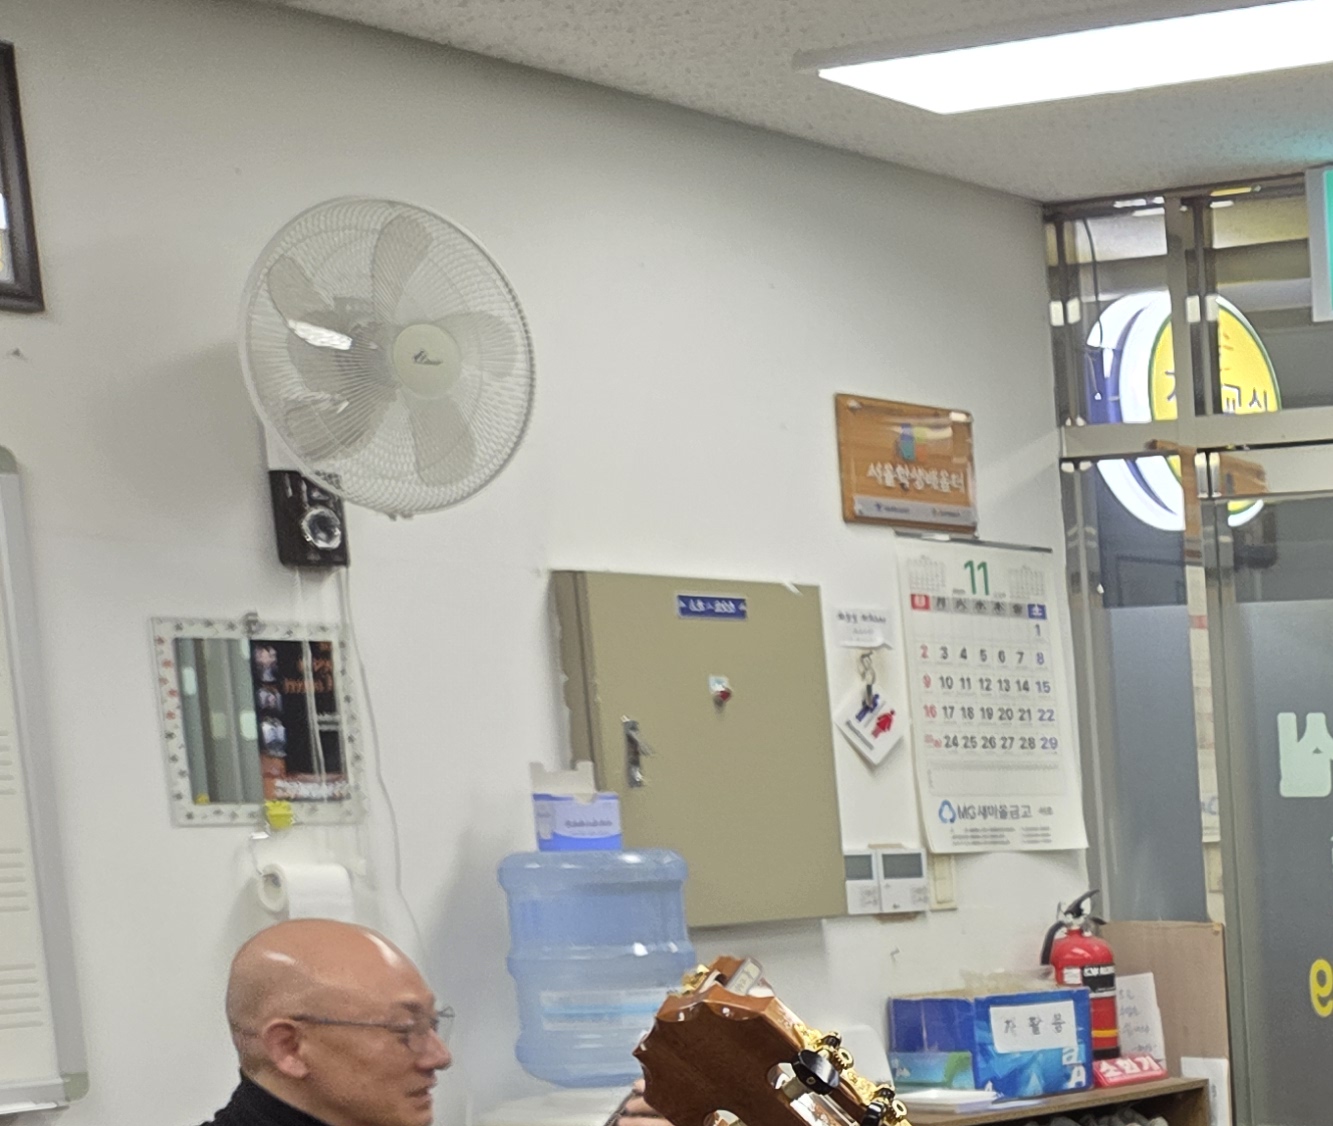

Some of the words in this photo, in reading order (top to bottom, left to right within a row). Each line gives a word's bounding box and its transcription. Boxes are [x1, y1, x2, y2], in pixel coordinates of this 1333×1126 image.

[964, 560, 989, 595] 11
[920, 644, 928, 659] 2
[940, 646, 948, 660] 3
[960, 647, 967, 660] 4
[980, 649, 987, 662] 5
[998, 650, 1006, 663] 6
[1016, 651, 1024, 664] 7
[1036, 652, 1044, 665] 8
[940, 675, 953, 689] 10
[960, 677, 971, 690] 11
[979, 678, 992, 691] 12
[998, 679, 1010, 692] 13
[1016, 680, 1029, 692] 14
[1035, 681, 1050, 693] 15
[923, 704, 937, 719] 16
[942, 705, 954, 719] 17
[961, 706, 974, 720] 18
[980, 707, 993, 720] 19
[998, 708, 1013, 721] 20
[1018, 708, 1031, 721] 21
[1038, 709, 1055, 721] 22
[944, 735, 958, 748] 24
[963, 735, 977, 749] 25
[981, 736, 996, 749] 26
[1001, 737, 1015, 749] 27
[1020, 737, 1035, 750] 28
[1041, 737, 1058, 750] 29
